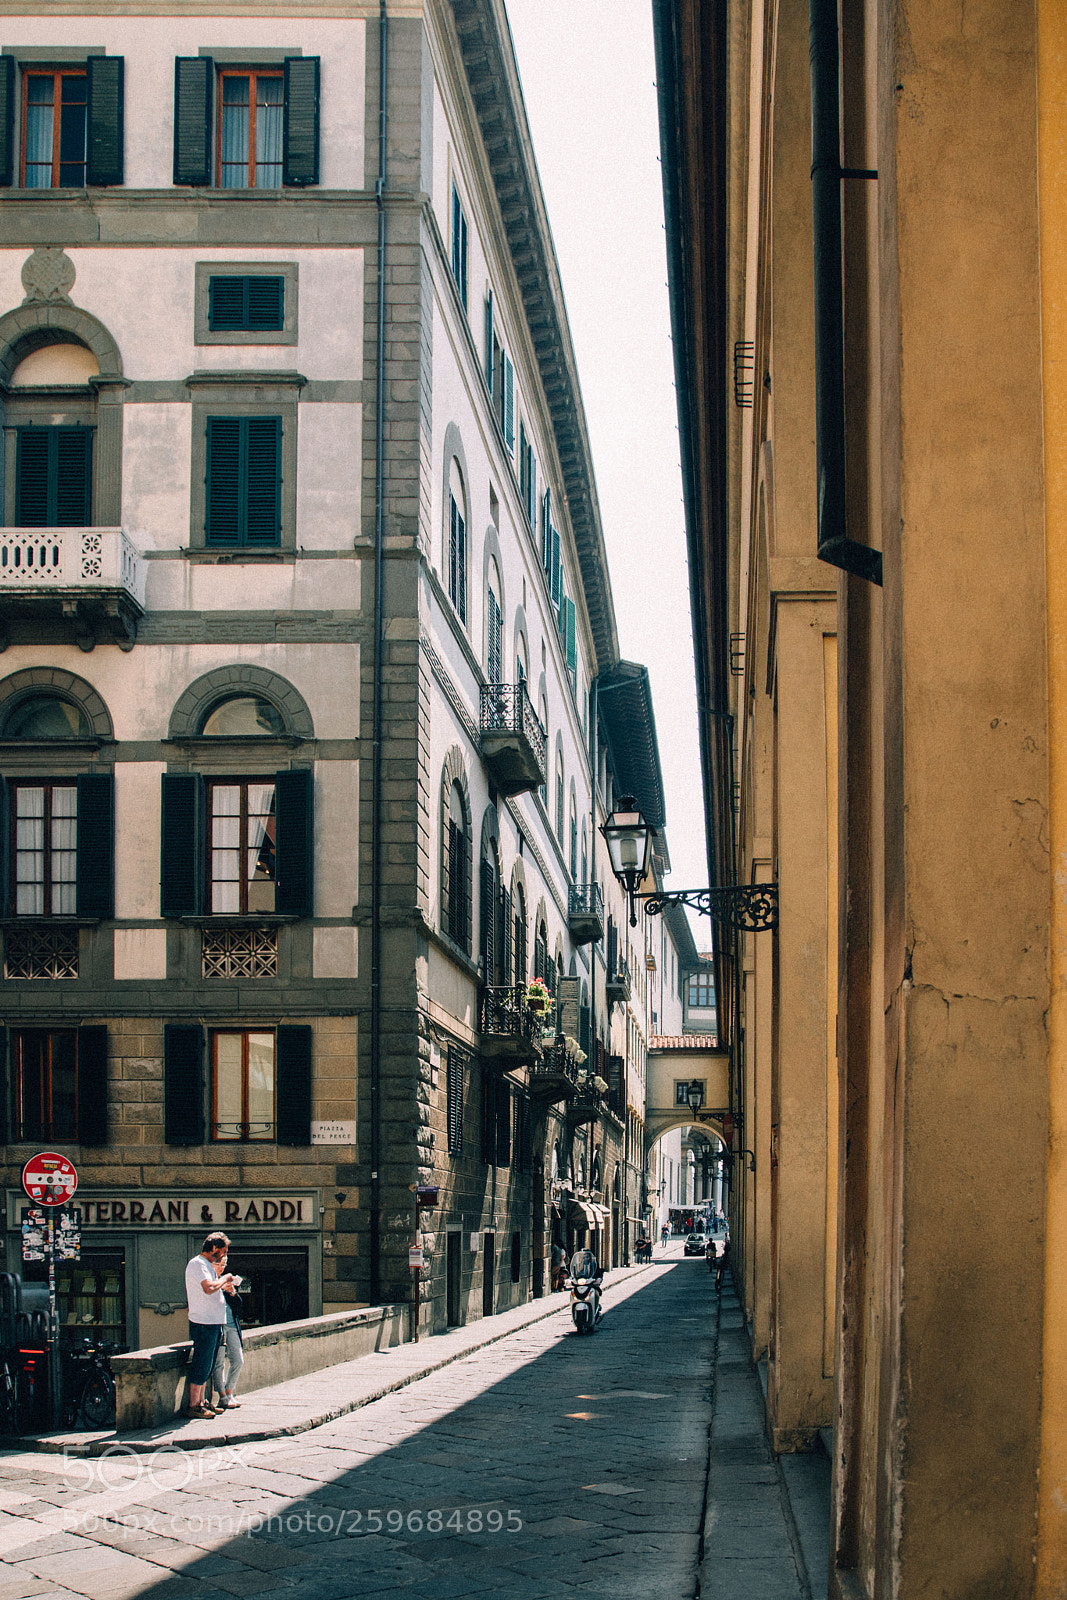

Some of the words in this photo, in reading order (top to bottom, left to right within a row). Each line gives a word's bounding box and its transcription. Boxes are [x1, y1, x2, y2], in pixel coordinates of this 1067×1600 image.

[29, 1201, 189, 1223] TERRANI
[200, 1205, 213, 1222] &
[225, 1201, 304, 1223] RADDI
